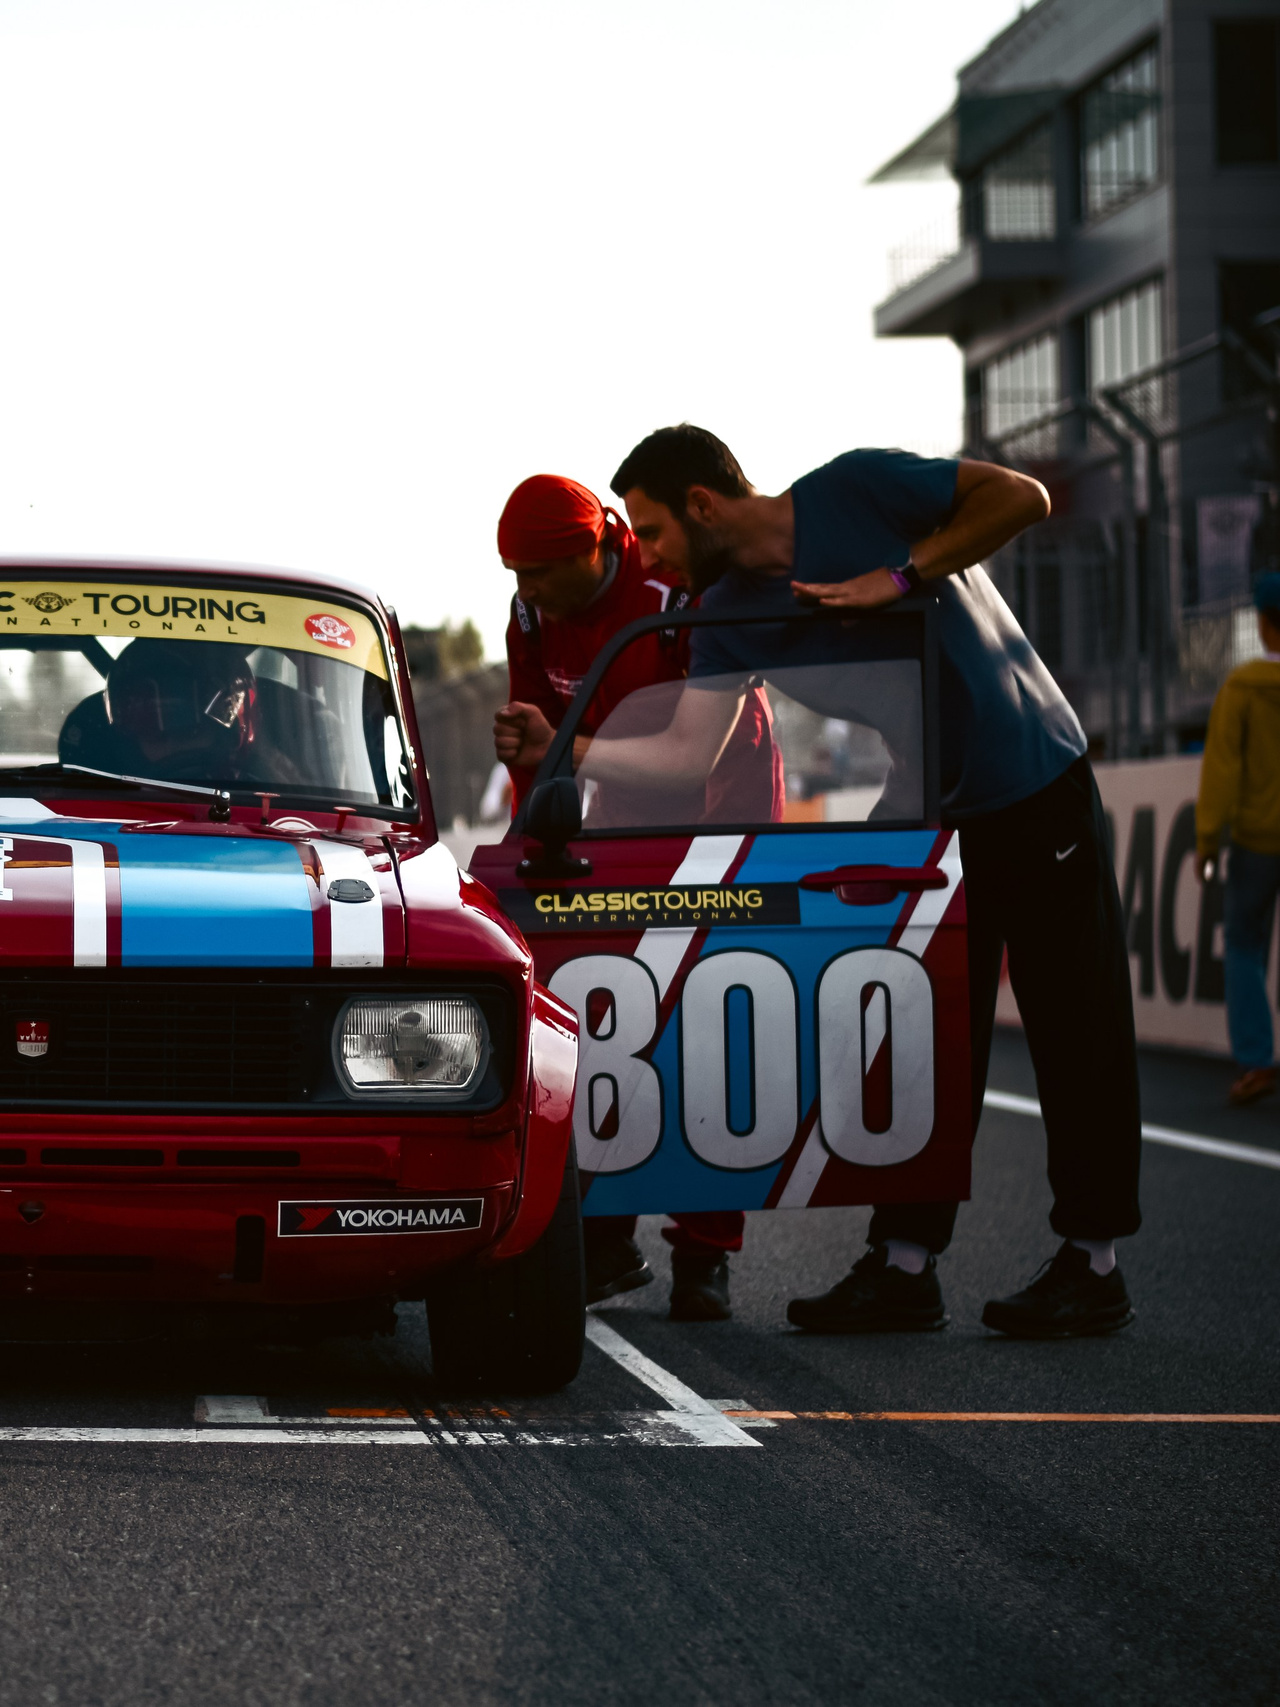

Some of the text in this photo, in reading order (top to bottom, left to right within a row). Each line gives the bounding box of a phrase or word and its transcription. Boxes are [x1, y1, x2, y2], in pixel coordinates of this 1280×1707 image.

[82, 592, 266, 625] TOURING
[544, 910, 754, 924] INTERNATIONAL
[546, 945, 935, 1174] 800
[335, 1206, 467, 1228] YOKOHAMA
